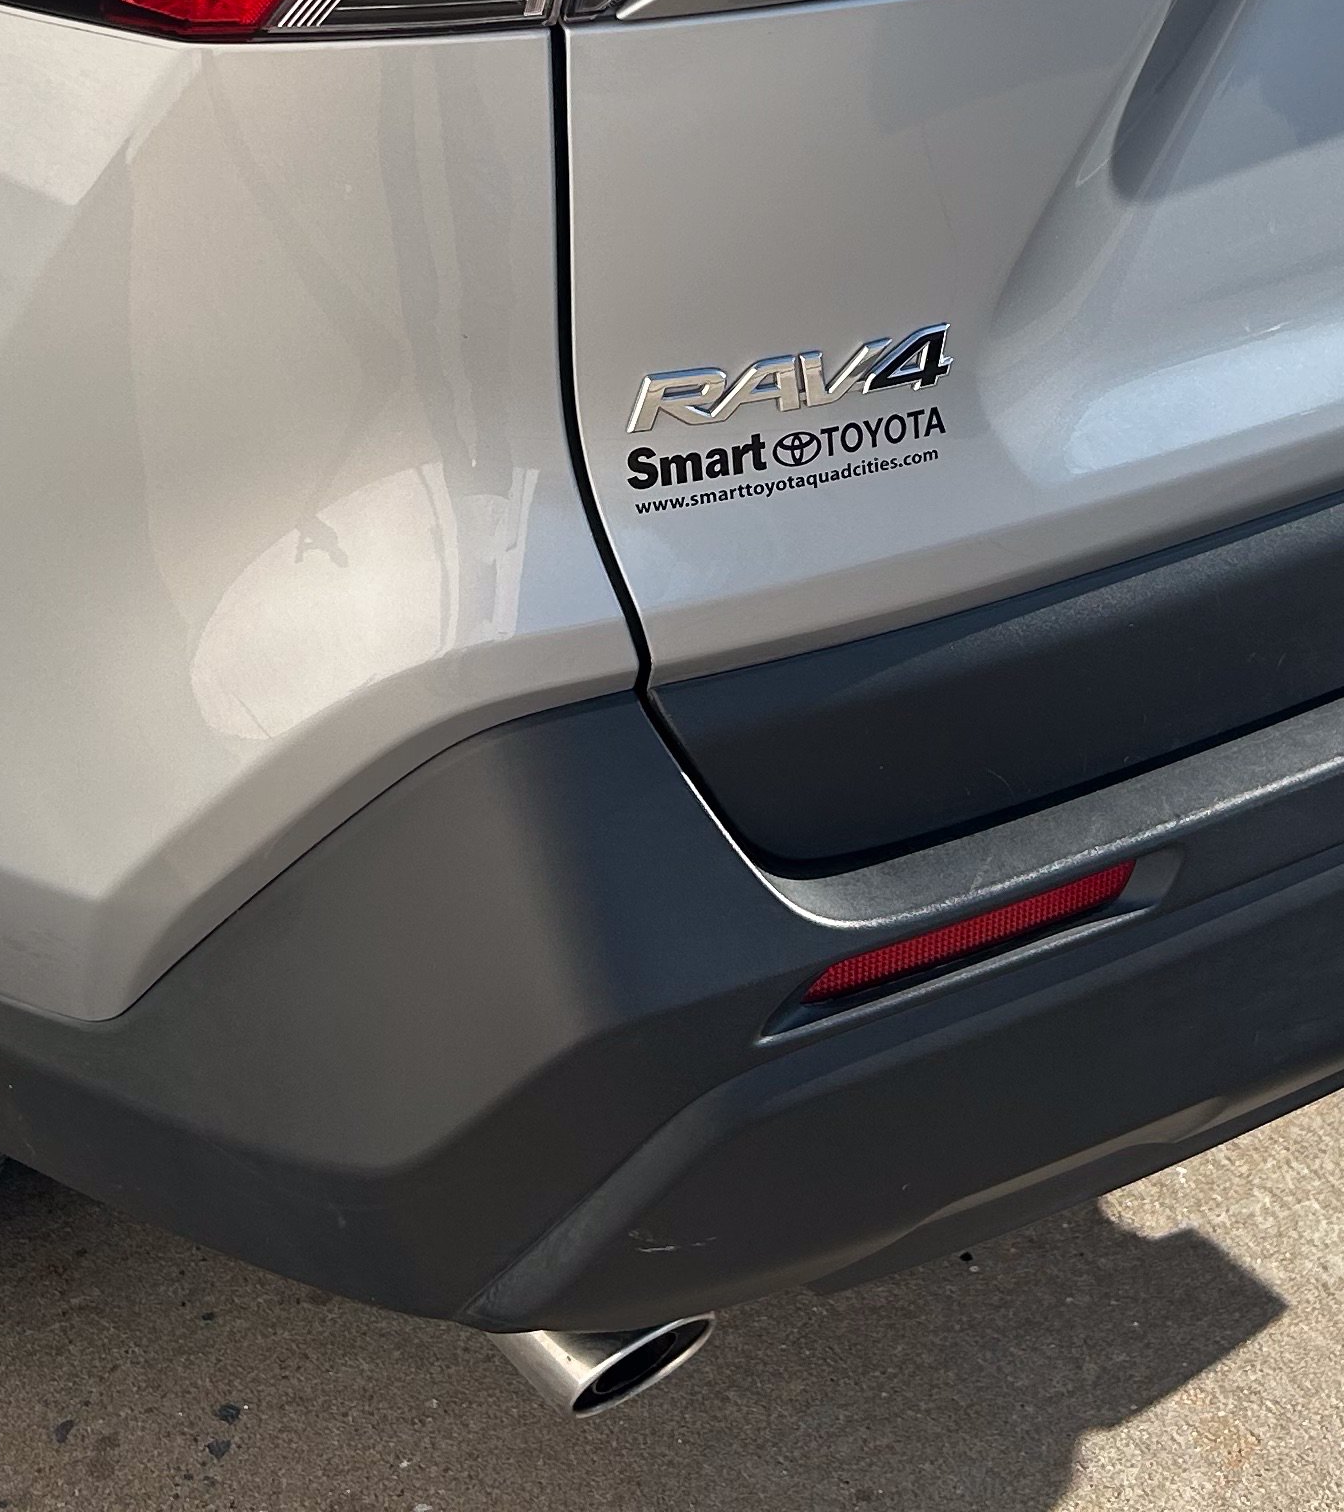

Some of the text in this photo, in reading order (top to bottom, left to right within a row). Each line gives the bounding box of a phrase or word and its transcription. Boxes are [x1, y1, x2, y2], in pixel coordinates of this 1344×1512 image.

[625, 321, 954, 434] RAV4
[626, 406, 946, 490] Smart TOYOTA
[635, 447, 939, 514] www.smarttoyotaquadcities.com
